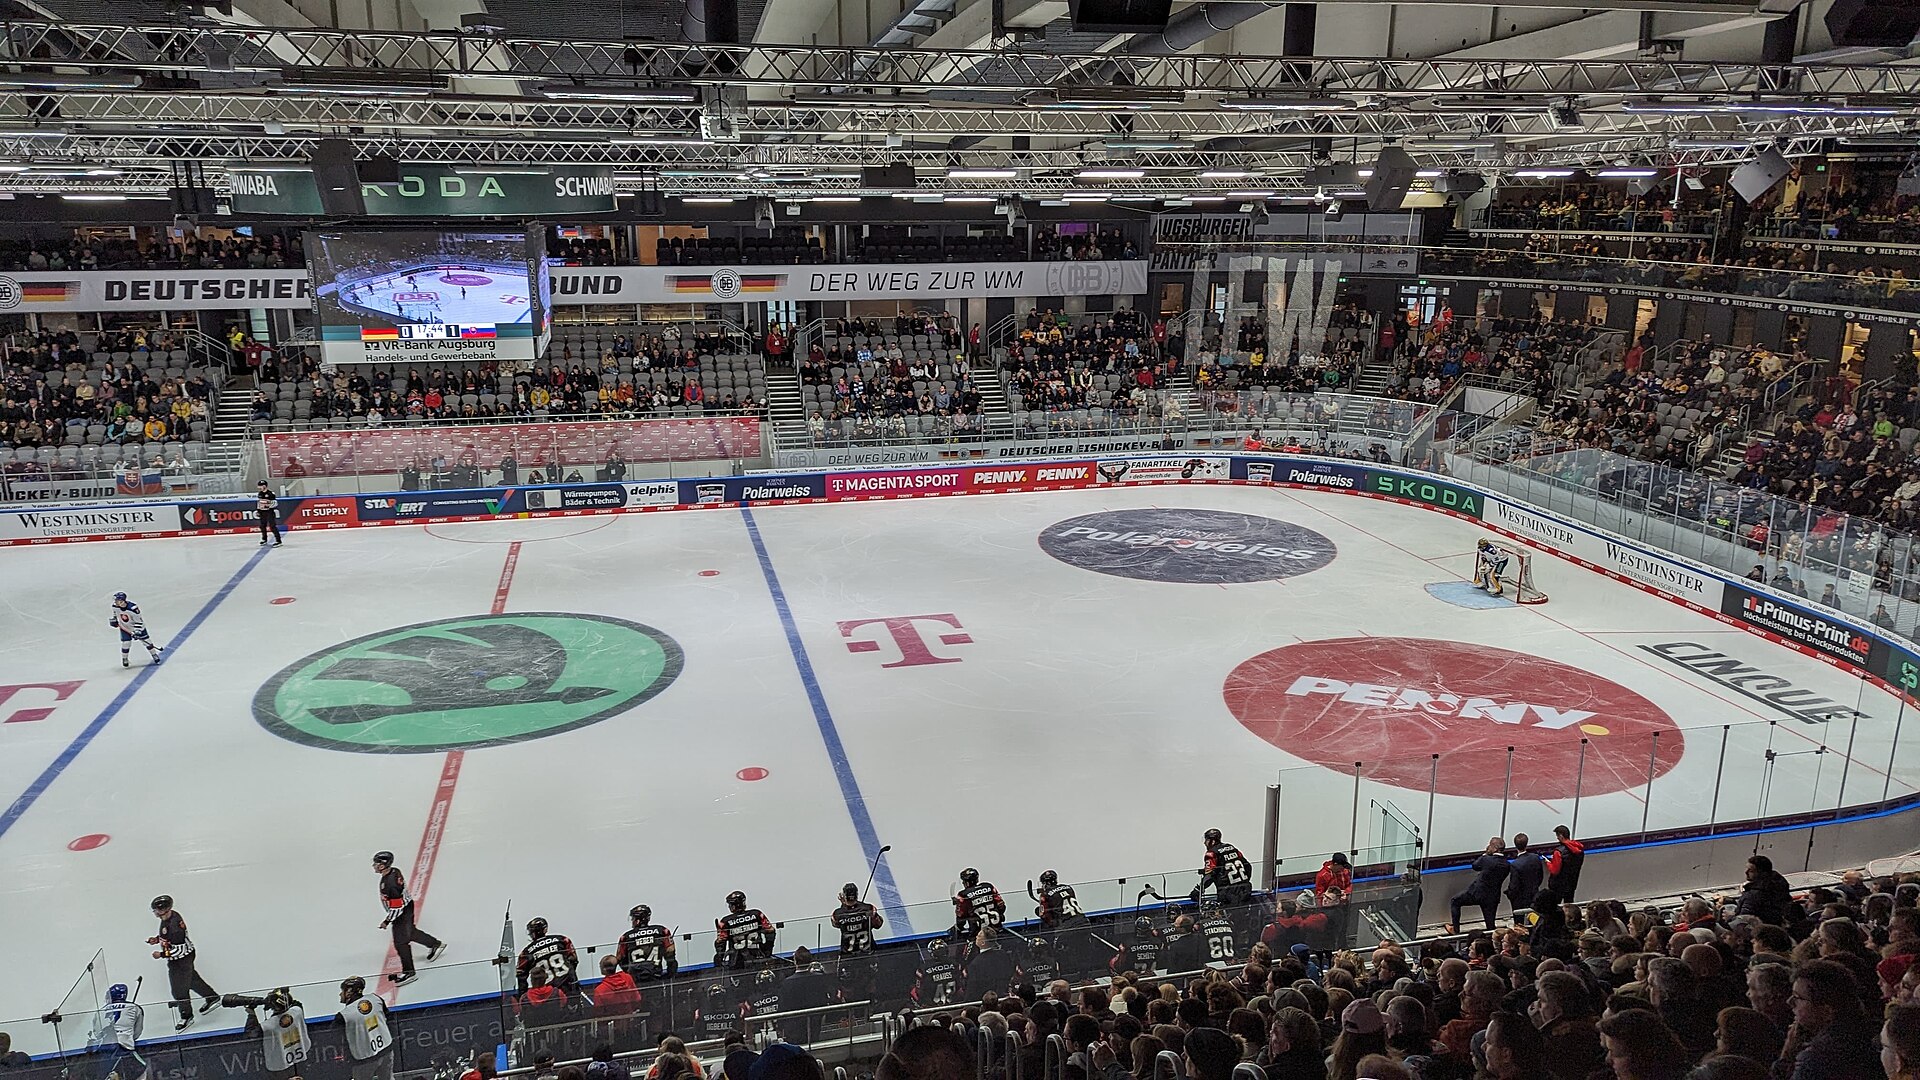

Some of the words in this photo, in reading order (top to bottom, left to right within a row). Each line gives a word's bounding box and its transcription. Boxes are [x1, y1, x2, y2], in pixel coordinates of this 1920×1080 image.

[1153, 217, 1250, 236] AUGSBURGER
[1151, 252, 1217, 270] PANTHER
[810, 272, 857, 293] DER
[866, 271, 919, 292] WEG
[928, 271, 975, 291] ZUR
[985, 270, 1023, 290] WM
[105, 278, 311, 302] DEUTSCHER
[401, 326, 409, 337] 0
[417, 325, 443, 333] 17:44
[449, 325, 456, 337] 1
[383, 340, 435, 351] VR-Bank
[438, 339, 496, 352] Augsburg
[365, 354, 407, 362] Handels-
[409, 352, 429, 361] und
[431, 350, 497, 361] Gewerbebank
[1000, 444, 1073, 457] DEUTSCHER
[828, 454, 849, 465] DER
[855, 453, 879, 464] WEG
[882, 452, 906, 463] ZUR
[909, 451, 929, 462] WM
[1131, 460, 1183, 469] FANARTIKEL
[846, 476, 913, 490] MAGENTA
[916, 474, 959, 487] SPORT
[1289, 469, 1353, 488] Polarweiss
[564, 489, 619, 500] Wärmepumpen,
[630, 485, 675, 496] delphis
[742, 484, 811, 499] Polarweiss
[565, 498, 585, 506] Bäder
[594, 496, 620, 505] Technik
[302, 509, 312, 517] IT
[313, 507, 349, 517] SUPPLY
[18, 511, 155, 529] WESTMINSTER
[1497, 502, 1573, 546] WESTMINSTER
[43, 525, 136, 537] UNTERNEHMENSGRUPPE
[1605, 542, 1704, 593] WESTMINSTER
[1618, 564, 1686, 598] UNTERNEHMENSGRUPPE
[1762, 602, 1869, 656] Primus-Print.de
[1743, 611, 1793, 636] Höchstleistung
[1793, 628, 1806, 640] bei
[1806, 633, 1866, 666] Druckprodukten.
[967, 887, 991, 898] SKODA
[727, 914, 757, 926] SKODA
[839, 915, 867, 925] SKODA
[1203, 920, 1229, 928] SKODA
[629, 928, 659, 938] SKODA
[528, 937, 559, 953] SKODA
[1131, 944, 1159, 952] SKODA
[926, 963, 955, 974] SKODA
[703, 1013, 736, 1021] SKODA
[370, 1034, 384, 1052] 08
[401, 1023, 478, 1051] Feuer
[285, 1047, 304, 1064] 05
